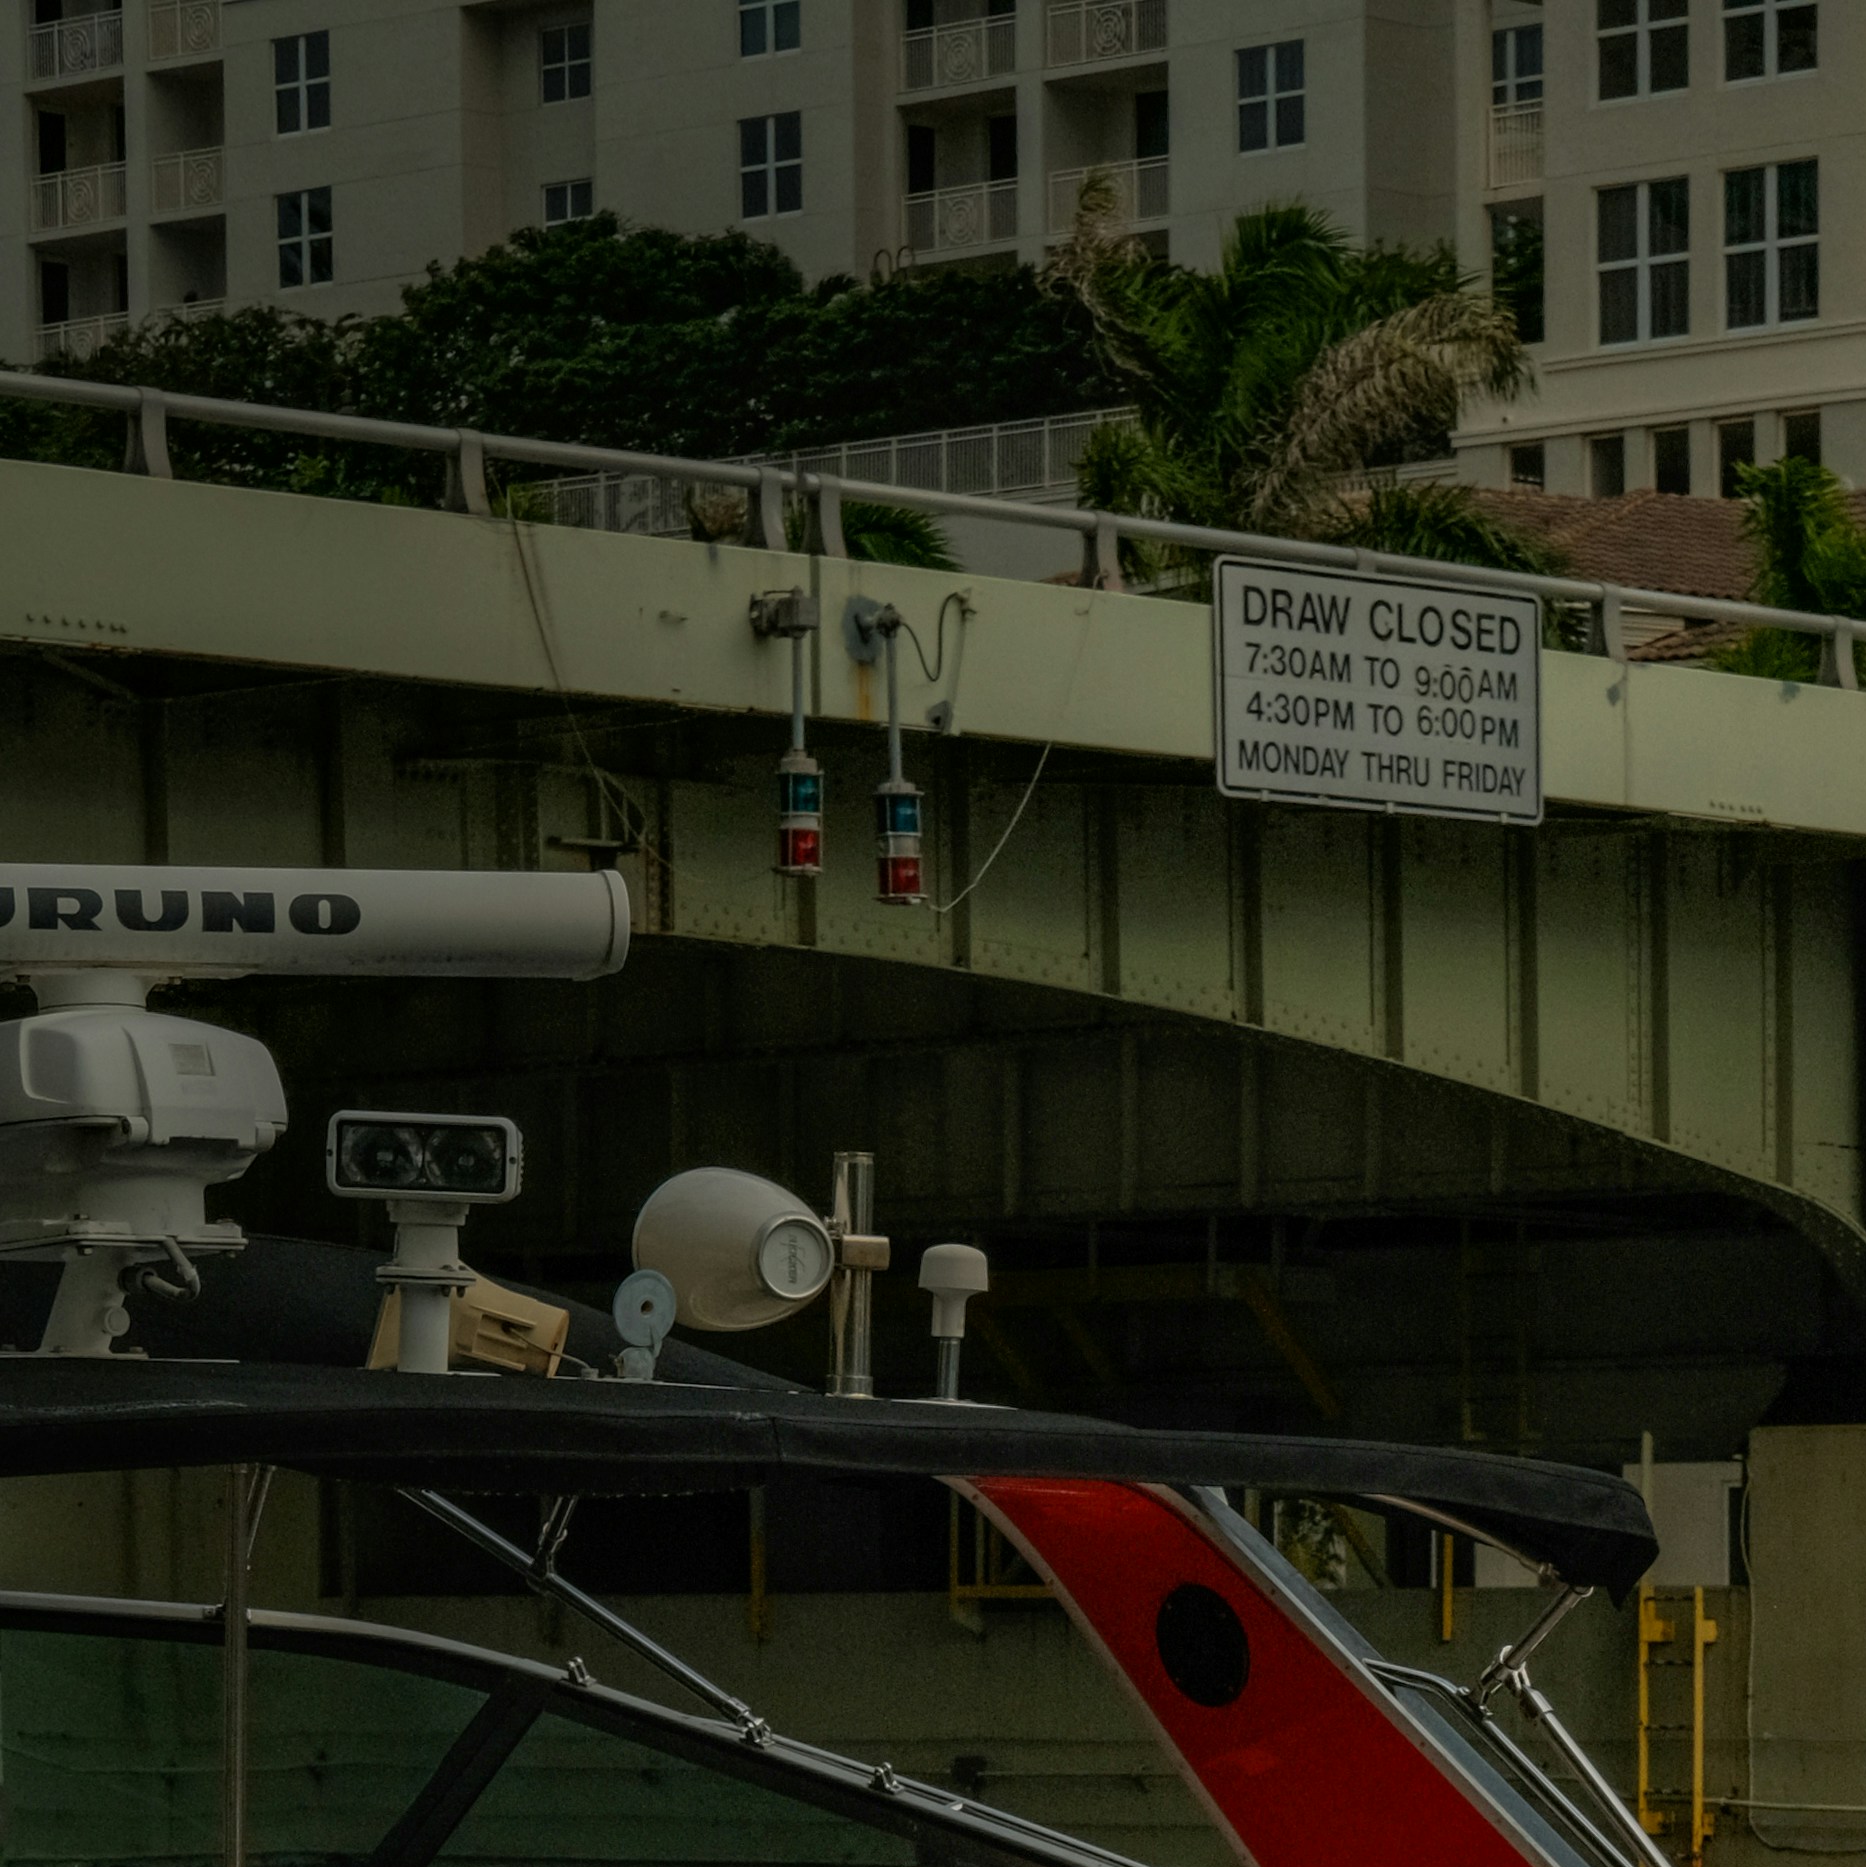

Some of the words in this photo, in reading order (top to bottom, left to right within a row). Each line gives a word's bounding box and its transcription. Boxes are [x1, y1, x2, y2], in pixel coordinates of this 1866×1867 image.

[1242, 586, 1351, 636] DRAW
[1369, 600, 1521, 656] CLOSED
[1245, 643, 1352, 683] 7:30AM
[1365, 656, 1400, 688] TO
[1415, 664, 1518, 702] 9:00AM
[1246, 692, 1355, 731] 4:30PM
[1369, 704, 1402, 736] TO
[1417, 706, 1519, 749] 6:00PM
[1238, 740, 1349, 779] MONDAY
[1362, 752, 1430, 788] THRU
[1443, 761, 1526, 798] FRIDAY
